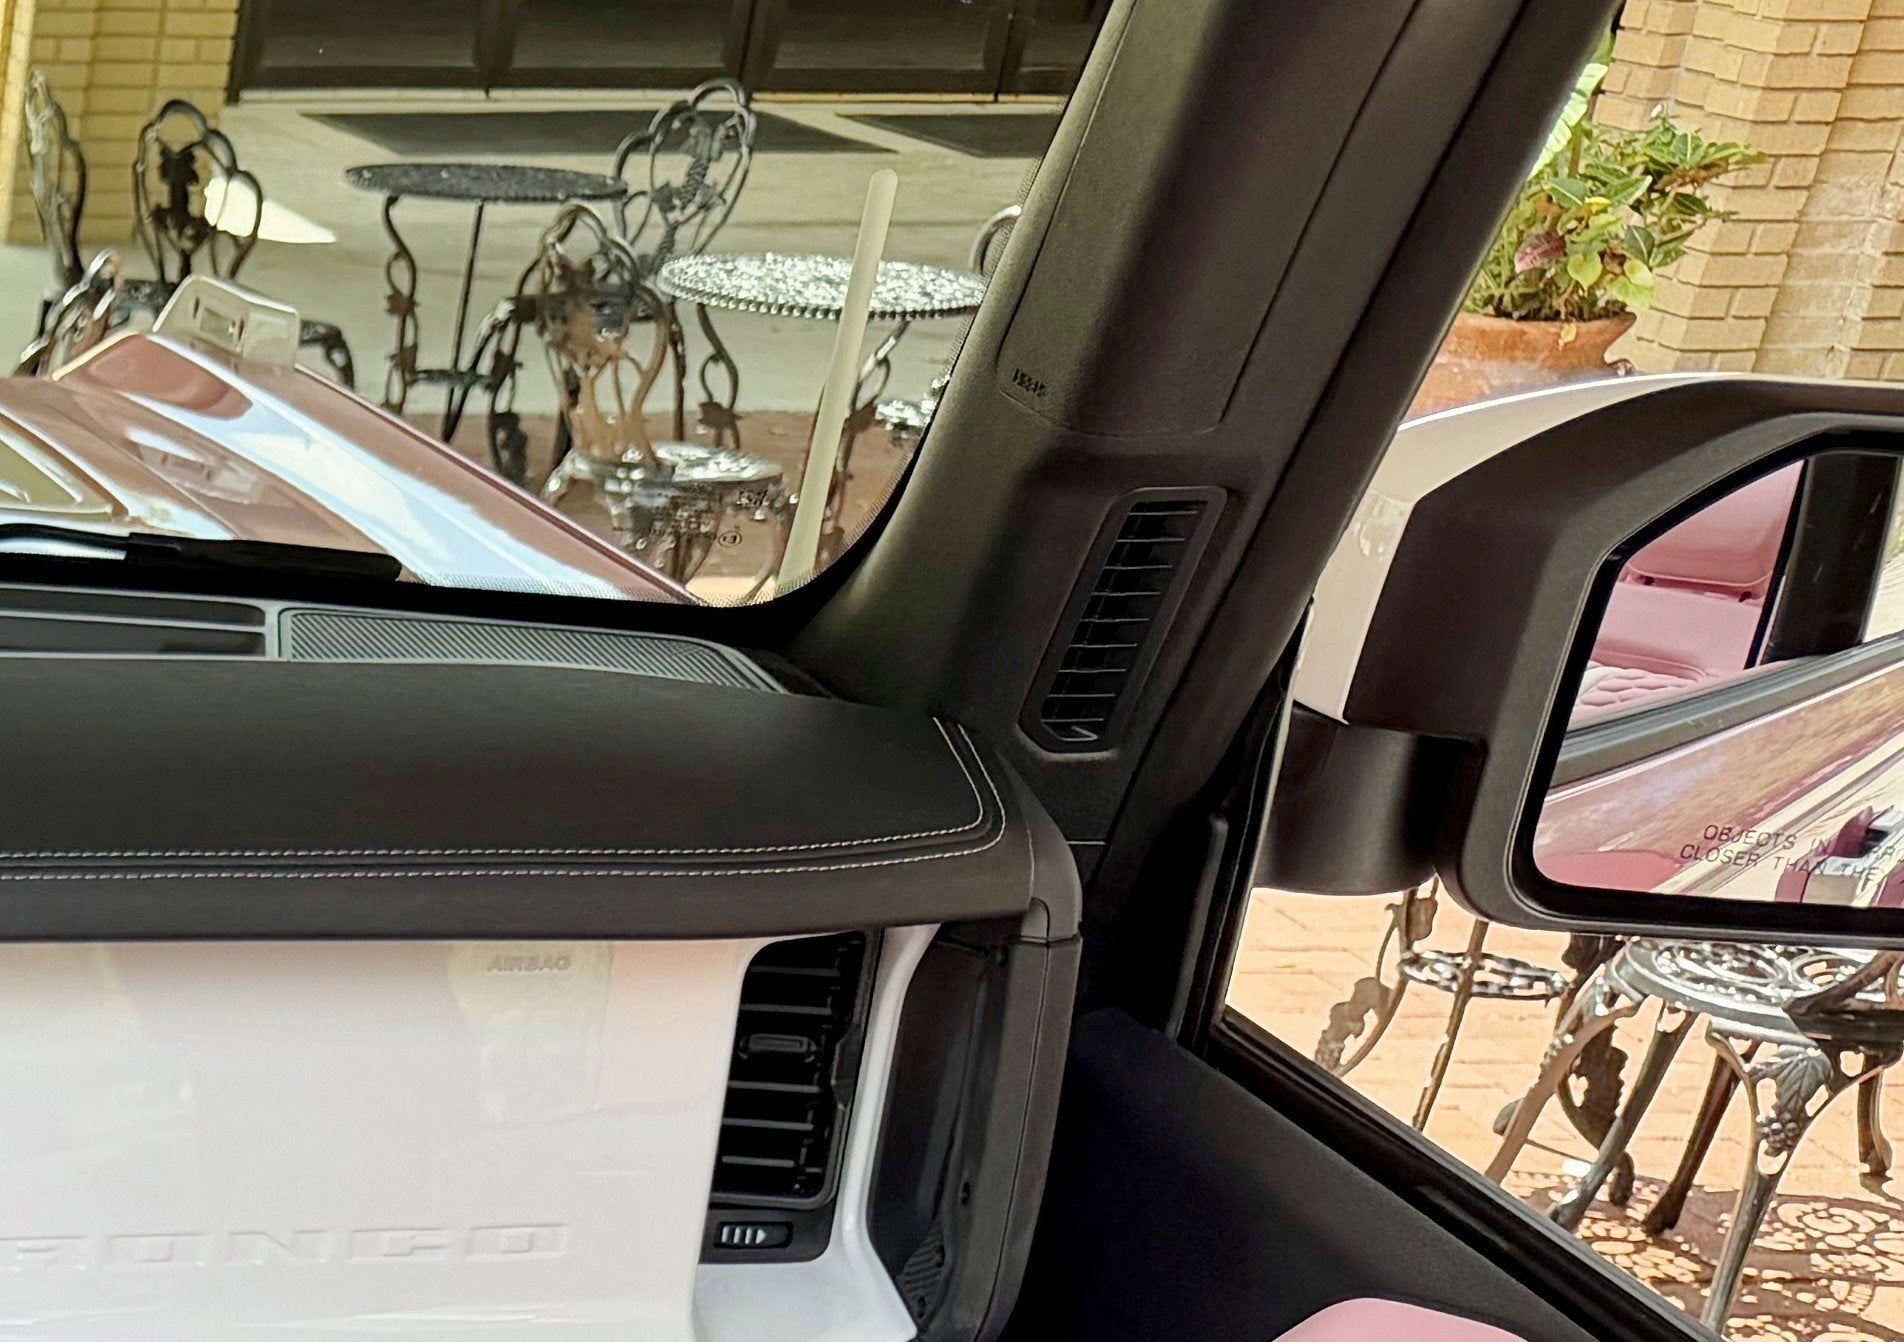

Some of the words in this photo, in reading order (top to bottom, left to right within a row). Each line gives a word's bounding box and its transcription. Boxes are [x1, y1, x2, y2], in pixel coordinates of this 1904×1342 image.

[1703, 824, 1798, 850] OBJECTS
[1679, 844, 1762, 867] CLOSER
[1773, 855, 1830, 875] THAN
[487, 953, 573, 973] AIRBAG
